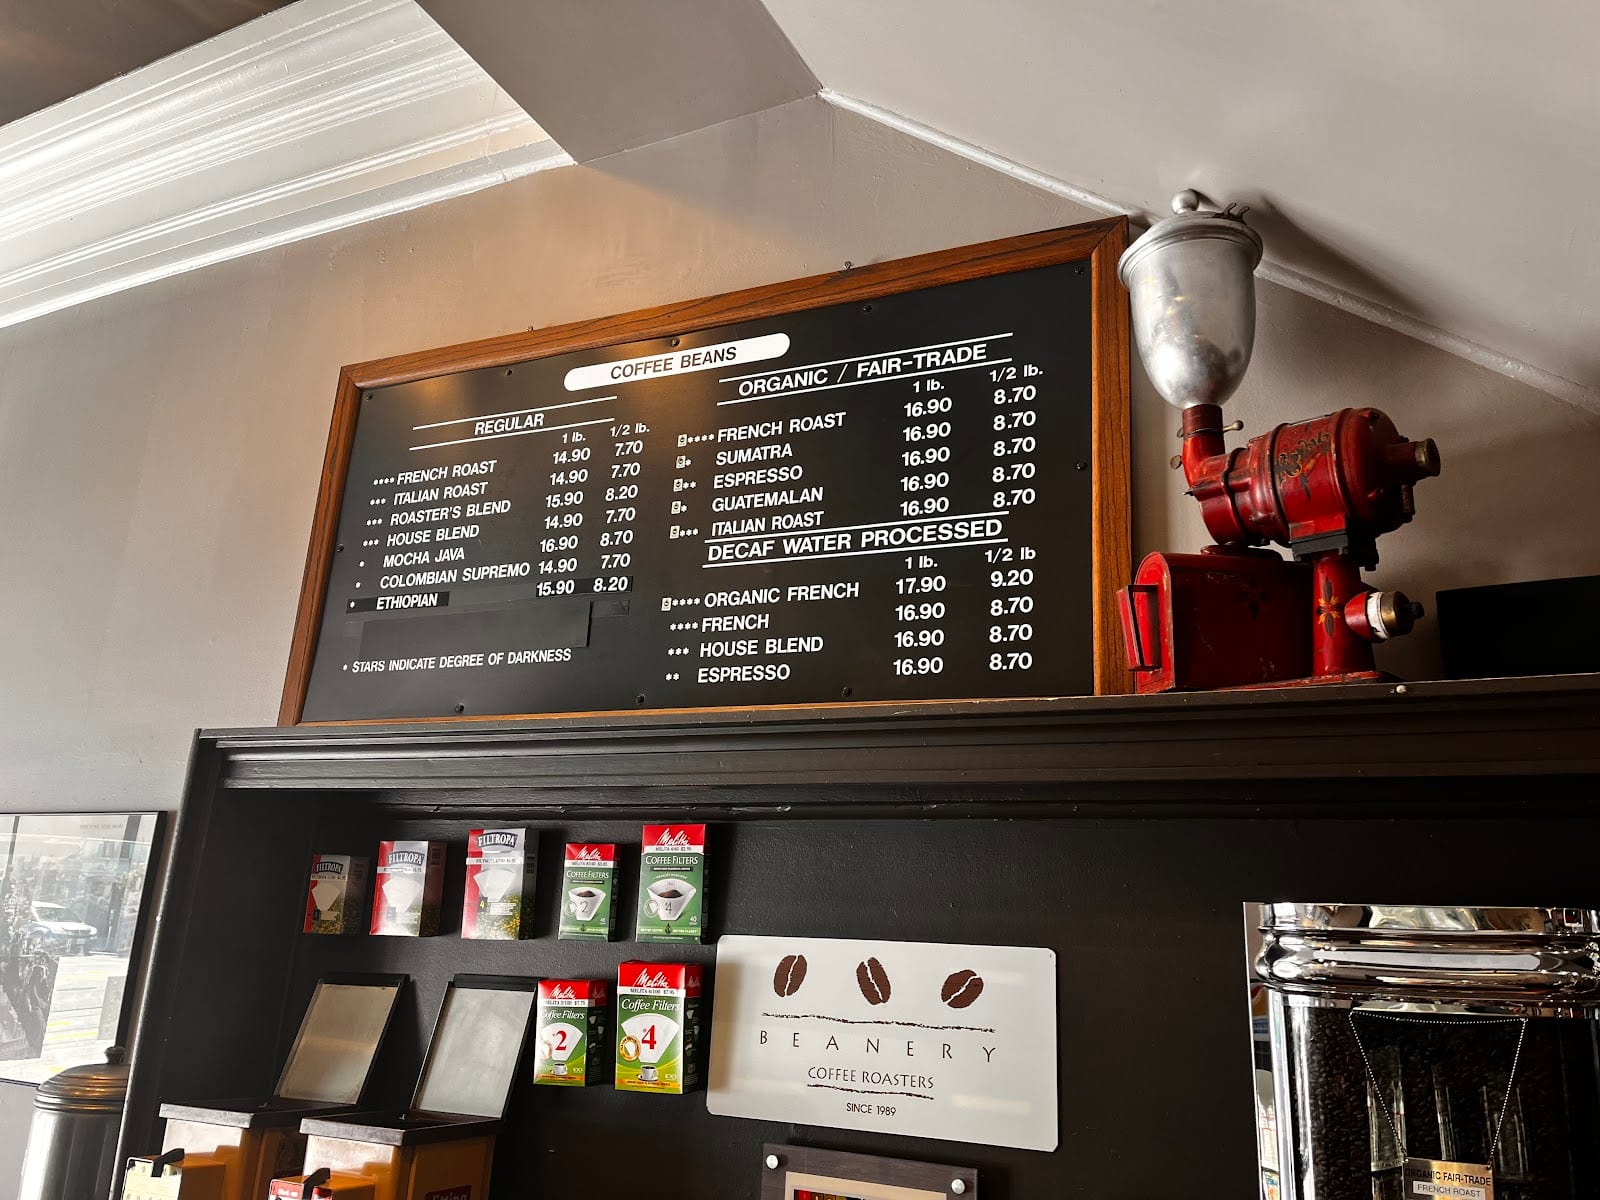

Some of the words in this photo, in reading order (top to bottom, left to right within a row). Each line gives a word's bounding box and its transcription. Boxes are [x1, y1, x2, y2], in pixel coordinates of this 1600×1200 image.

[611, 362, 674, 380] COFFEE
[680, 346, 737, 368] BEANS
[739, 369, 828, 396] ORGANIC
[837, 364, 848, 383] /
[857, 343, 987, 378] FAIR-TRADE
[989, 367, 1016, 382] 1/2
[1024, 364, 1043, 377] lb.
[913, 381, 920, 393] 1
[927, 379, 944, 391] lb.
[994, 385, 1036, 404] 8.70
[904, 397, 952, 417] 16.90
[474, 413, 544, 435] REGULAR
[610, 424, 630, 437] 1/2
[635, 423, 650, 433] lb.
[717, 421, 782, 443] FRENCH
[789, 412, 846, 433] ROAST
[993, 411, 1036, 431] 8.70
[562, 433, 568, 443] 1
[572, 432, 586, 442] lb.
[903, 422, 951, 441] 16.90
[615, 440, 643, 456] 7.70
[716, 443, 793, 465] SUMATRA
[993, 436, 1036, 456] 8.70
[553, 447, 591, 464] 14.90
[902, 447, 950, 466] 16.90
[397, 466, 448, 485] FRENCH
[452, 460, 497, 477] ROAST
[550, 469, 588, 485] 14.90
[611, 462, 640, 478] 7.70
[714, 465, 803, 489] ESPRESSO
[992, 463, 1035, 483] 8.70
[900, 472, 949, 491] 16.90
[394, 488, 443, 505] ITALIAN
[443, 481, 488, 499] ROAST
[546, 491, 583, 508] 15.90
[605, 485, 638, 501] 8.20
[712, 487, 823, 512] GUATEMALAN
[993, 488, 1035, 508] 8.70
[390, 506, 461, 526] ROASTER'S
[466, 500, 511, 517] BLEND
[606, 507, 636, 524] 7.70
[900, 497, 949, 516] 16.90
[544, 513, 583, 529] 14.90
[712, 517, 766, 536] ITALIAN
[771, 511, 824, 530] ROAST
[387, 530, 432, 547] HOUSE
[436, 525, 479, 541] BLEND
[540, 535, 578, 552] 16.90
[600, 530, 633, 547] 8.70
[708, 540, 775, 561] DECAF
[783, 533, 851, 554] WATER
[861, 519, 1002, 548] PROCESSED
[383, 551, 430, 568] MOCHA
[435, 547, 465, 562] JAVA
[601, 553, 631, 569] 7.70
[905, 557, 912, 569] 1
[919, 555, 938, 568] lb.
[985, 548, 1013, 564] 1/2
[1020, 547, 1036, 560] lb
[538, 558, 577, 574] 14.90
[380, 569, 457, 589] COLOMBIAN
[462, 562, 530, 581] SUPREMO
[593, 576, 628, 592] 8.20
[896, 575, 946, 594] 17.90
[991, 569, 1033, 587] 9.20
[537, 580, 575, 596] 15.90
[704, 588, 780, 608] ORGANIC
[787, 582, 859, 601] FRENCH
[376, 593, 438, 610] ETHIOPIAN
[990, 596, 1033, 616] 8.70
[895, 602, 945, 621] 16.90
[702, 614, 769, 632] FRENCH
[894, 629, 944, 648] 16.90
[989, 624, 1032, 643] 8.70
[700, 640, 758, 657] HOUSE
[765, 636, 823, 654] BLEND
[352, 660, 385, 673] STARS
[389, 657, 436, 671] INDICATE
[439, 654, 484, 668] DEGREE
[488, 652, 504, 665] OF
[507, 648, 571, 664] DARKNESS
[893, 657, 943, 675] 16.90
[989, 652, 1032, 670] 8.70
[698, 664, 790, 683] ESPRESSO
[478, 832, 517, 847] FILTROPA
[656, 828, 690, 846] Melitta
[388, 851, 425, 865] FILTROPA
[576, 846, 601, 860] Melitta
[645, 855, 671, 865] COFFEE
[673, 855, 698, 865] FILTERS
[316, 862, 344, 874] FILTROPA
[566, 870, 587, 878] COFFEE
[588, 870, 609, 879] FILTERS
[634, 968, 670, 988] Melitta
[550, 984, 577, 999] Melitta
[621, 999, 650, 1012] Coffee
[652, 999, 680, 1011] Filters
[561, 1010, 585, 1020] Filters
[808, 1066, 856, 1083] COFFEE
[862, 1070, 935, 1089] ROASTERS
[846, 1102, 873, 1115] SINCE
[876, 1104, 897, 1117] 1989
[1404, 1168, 1441, 1180] ORGANIC
[1443, 1172, 1492, 1186] FAIR-TRADE
[1417, 1183, 1451, 1195] FRENCH
[1453, 1188, 1481, 1198] ROAST
